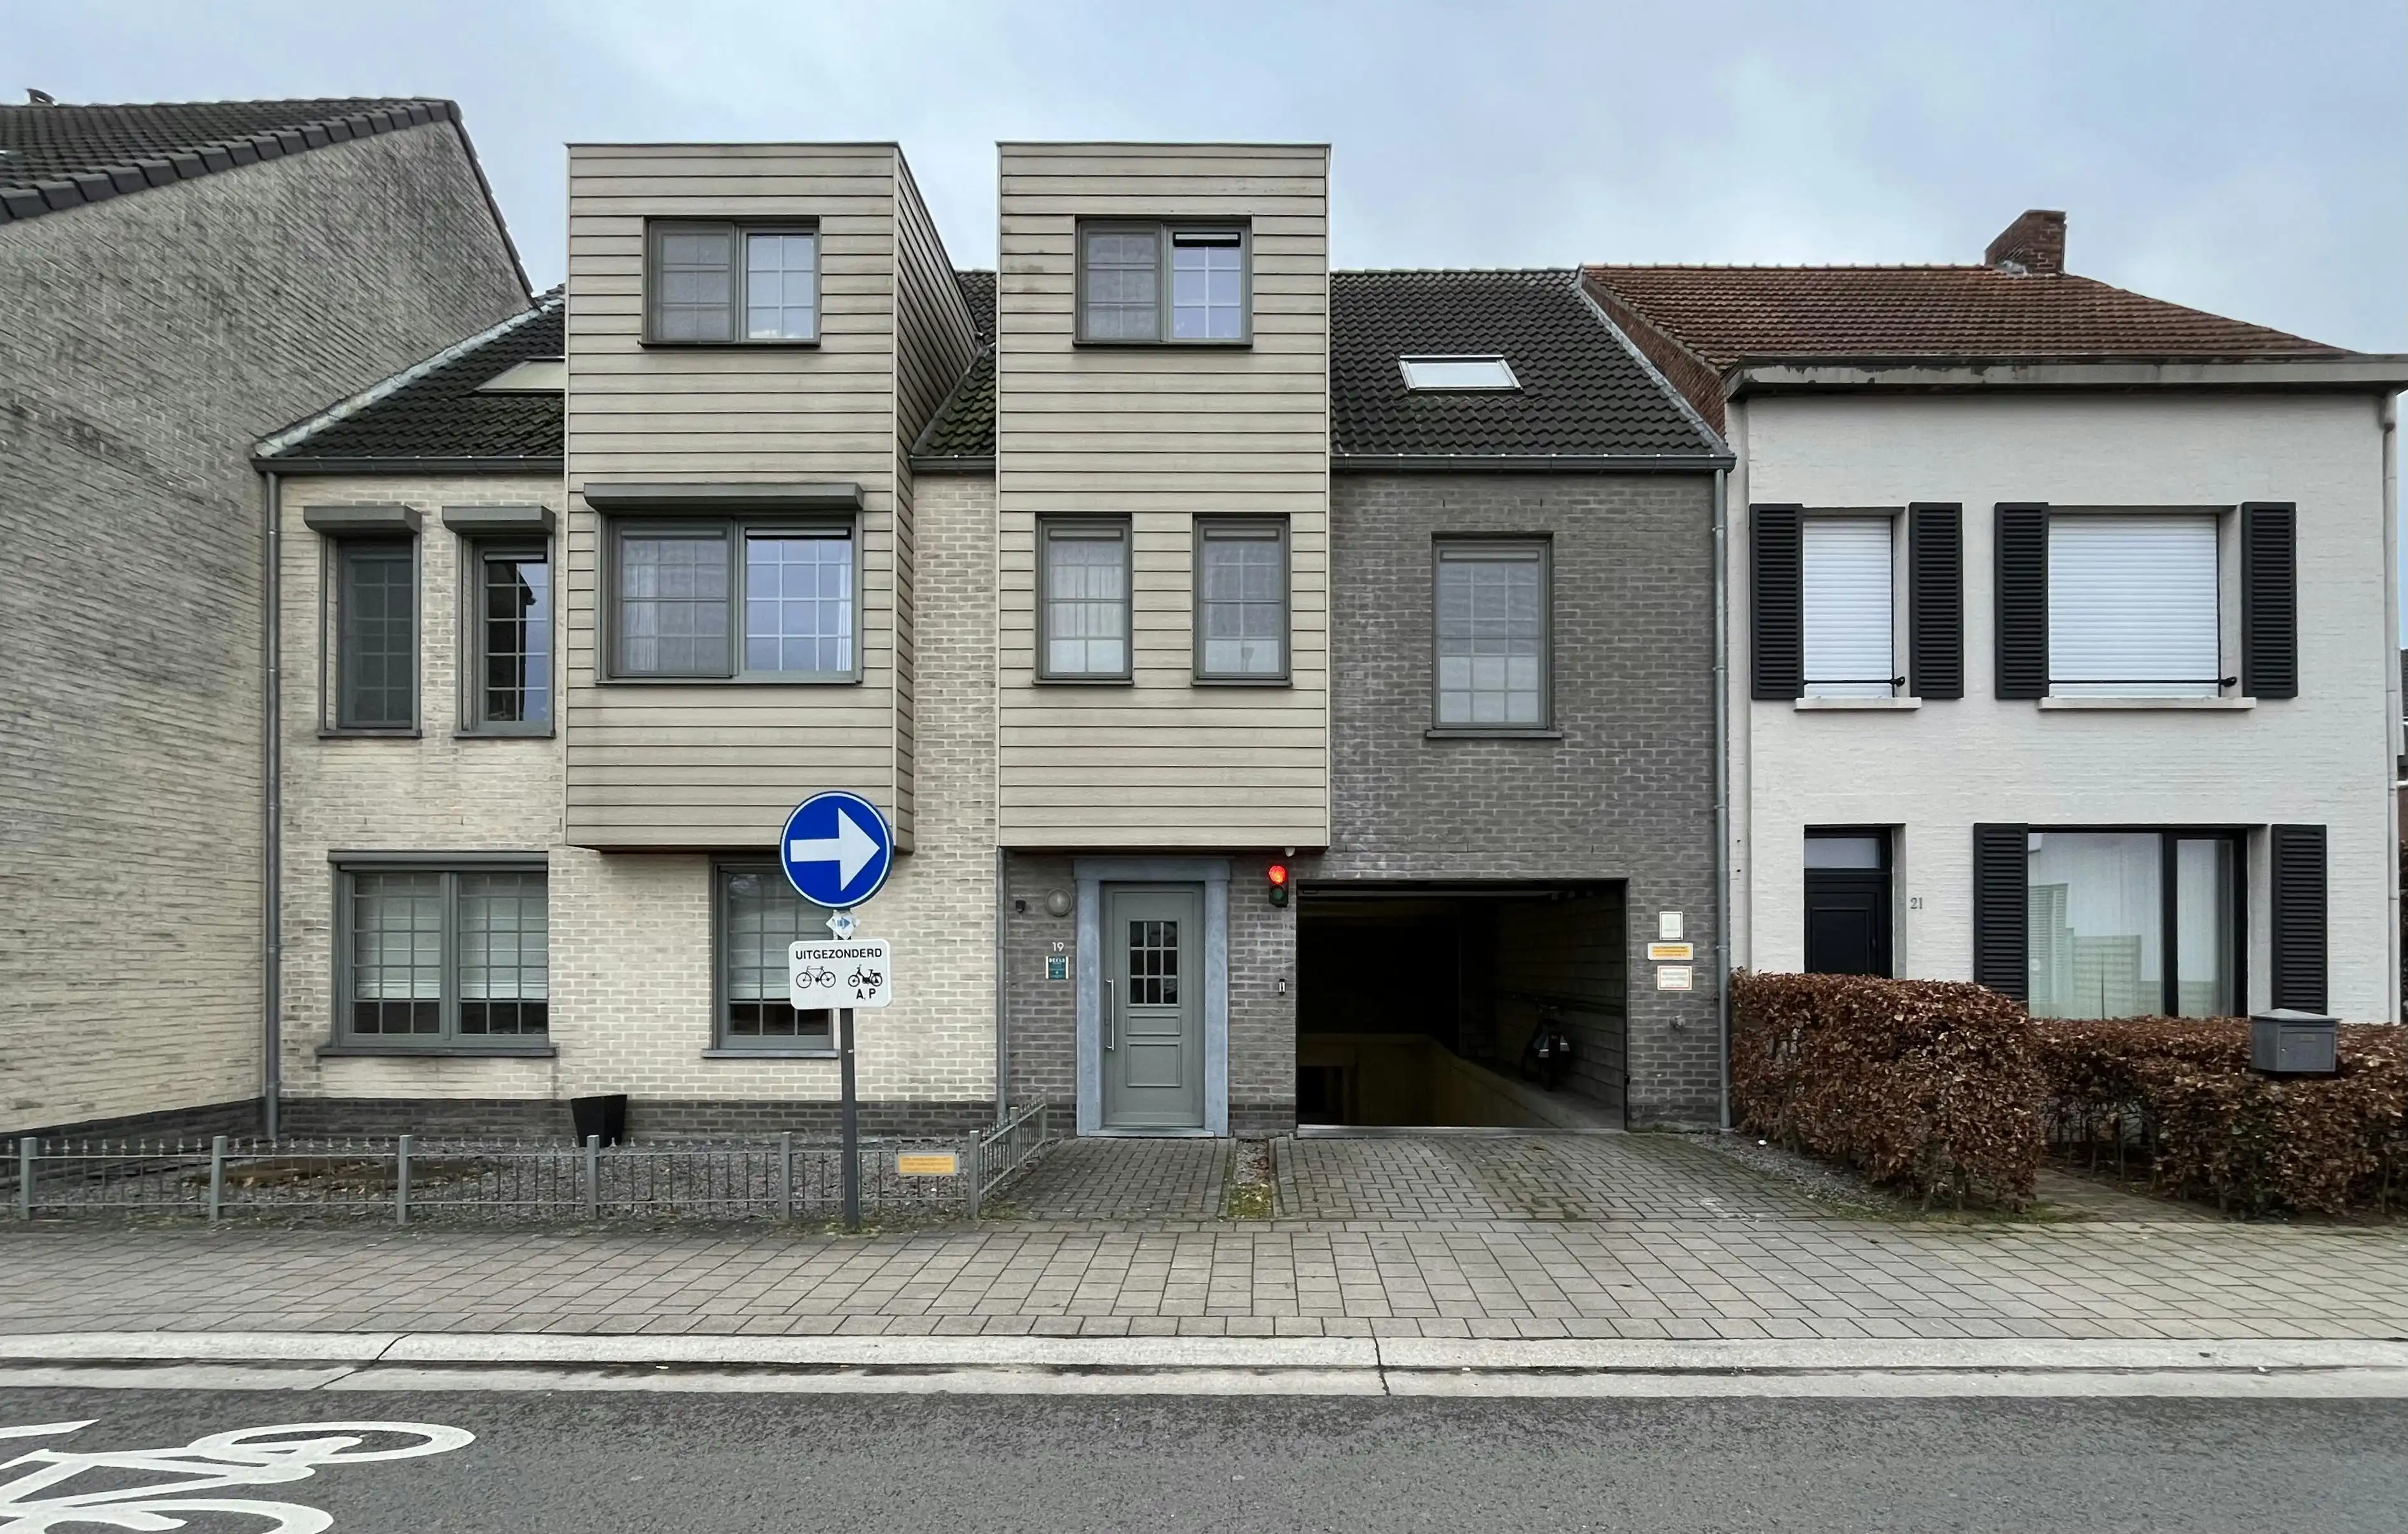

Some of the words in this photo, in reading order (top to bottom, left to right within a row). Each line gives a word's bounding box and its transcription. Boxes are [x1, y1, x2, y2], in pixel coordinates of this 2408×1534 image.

[1909, 896, 1923, 909] 21
[1052, 942, 1064, 952] 19
[795, 948, 882, 960] UITGEZONDERD
[869, 988, 876, 999] P
